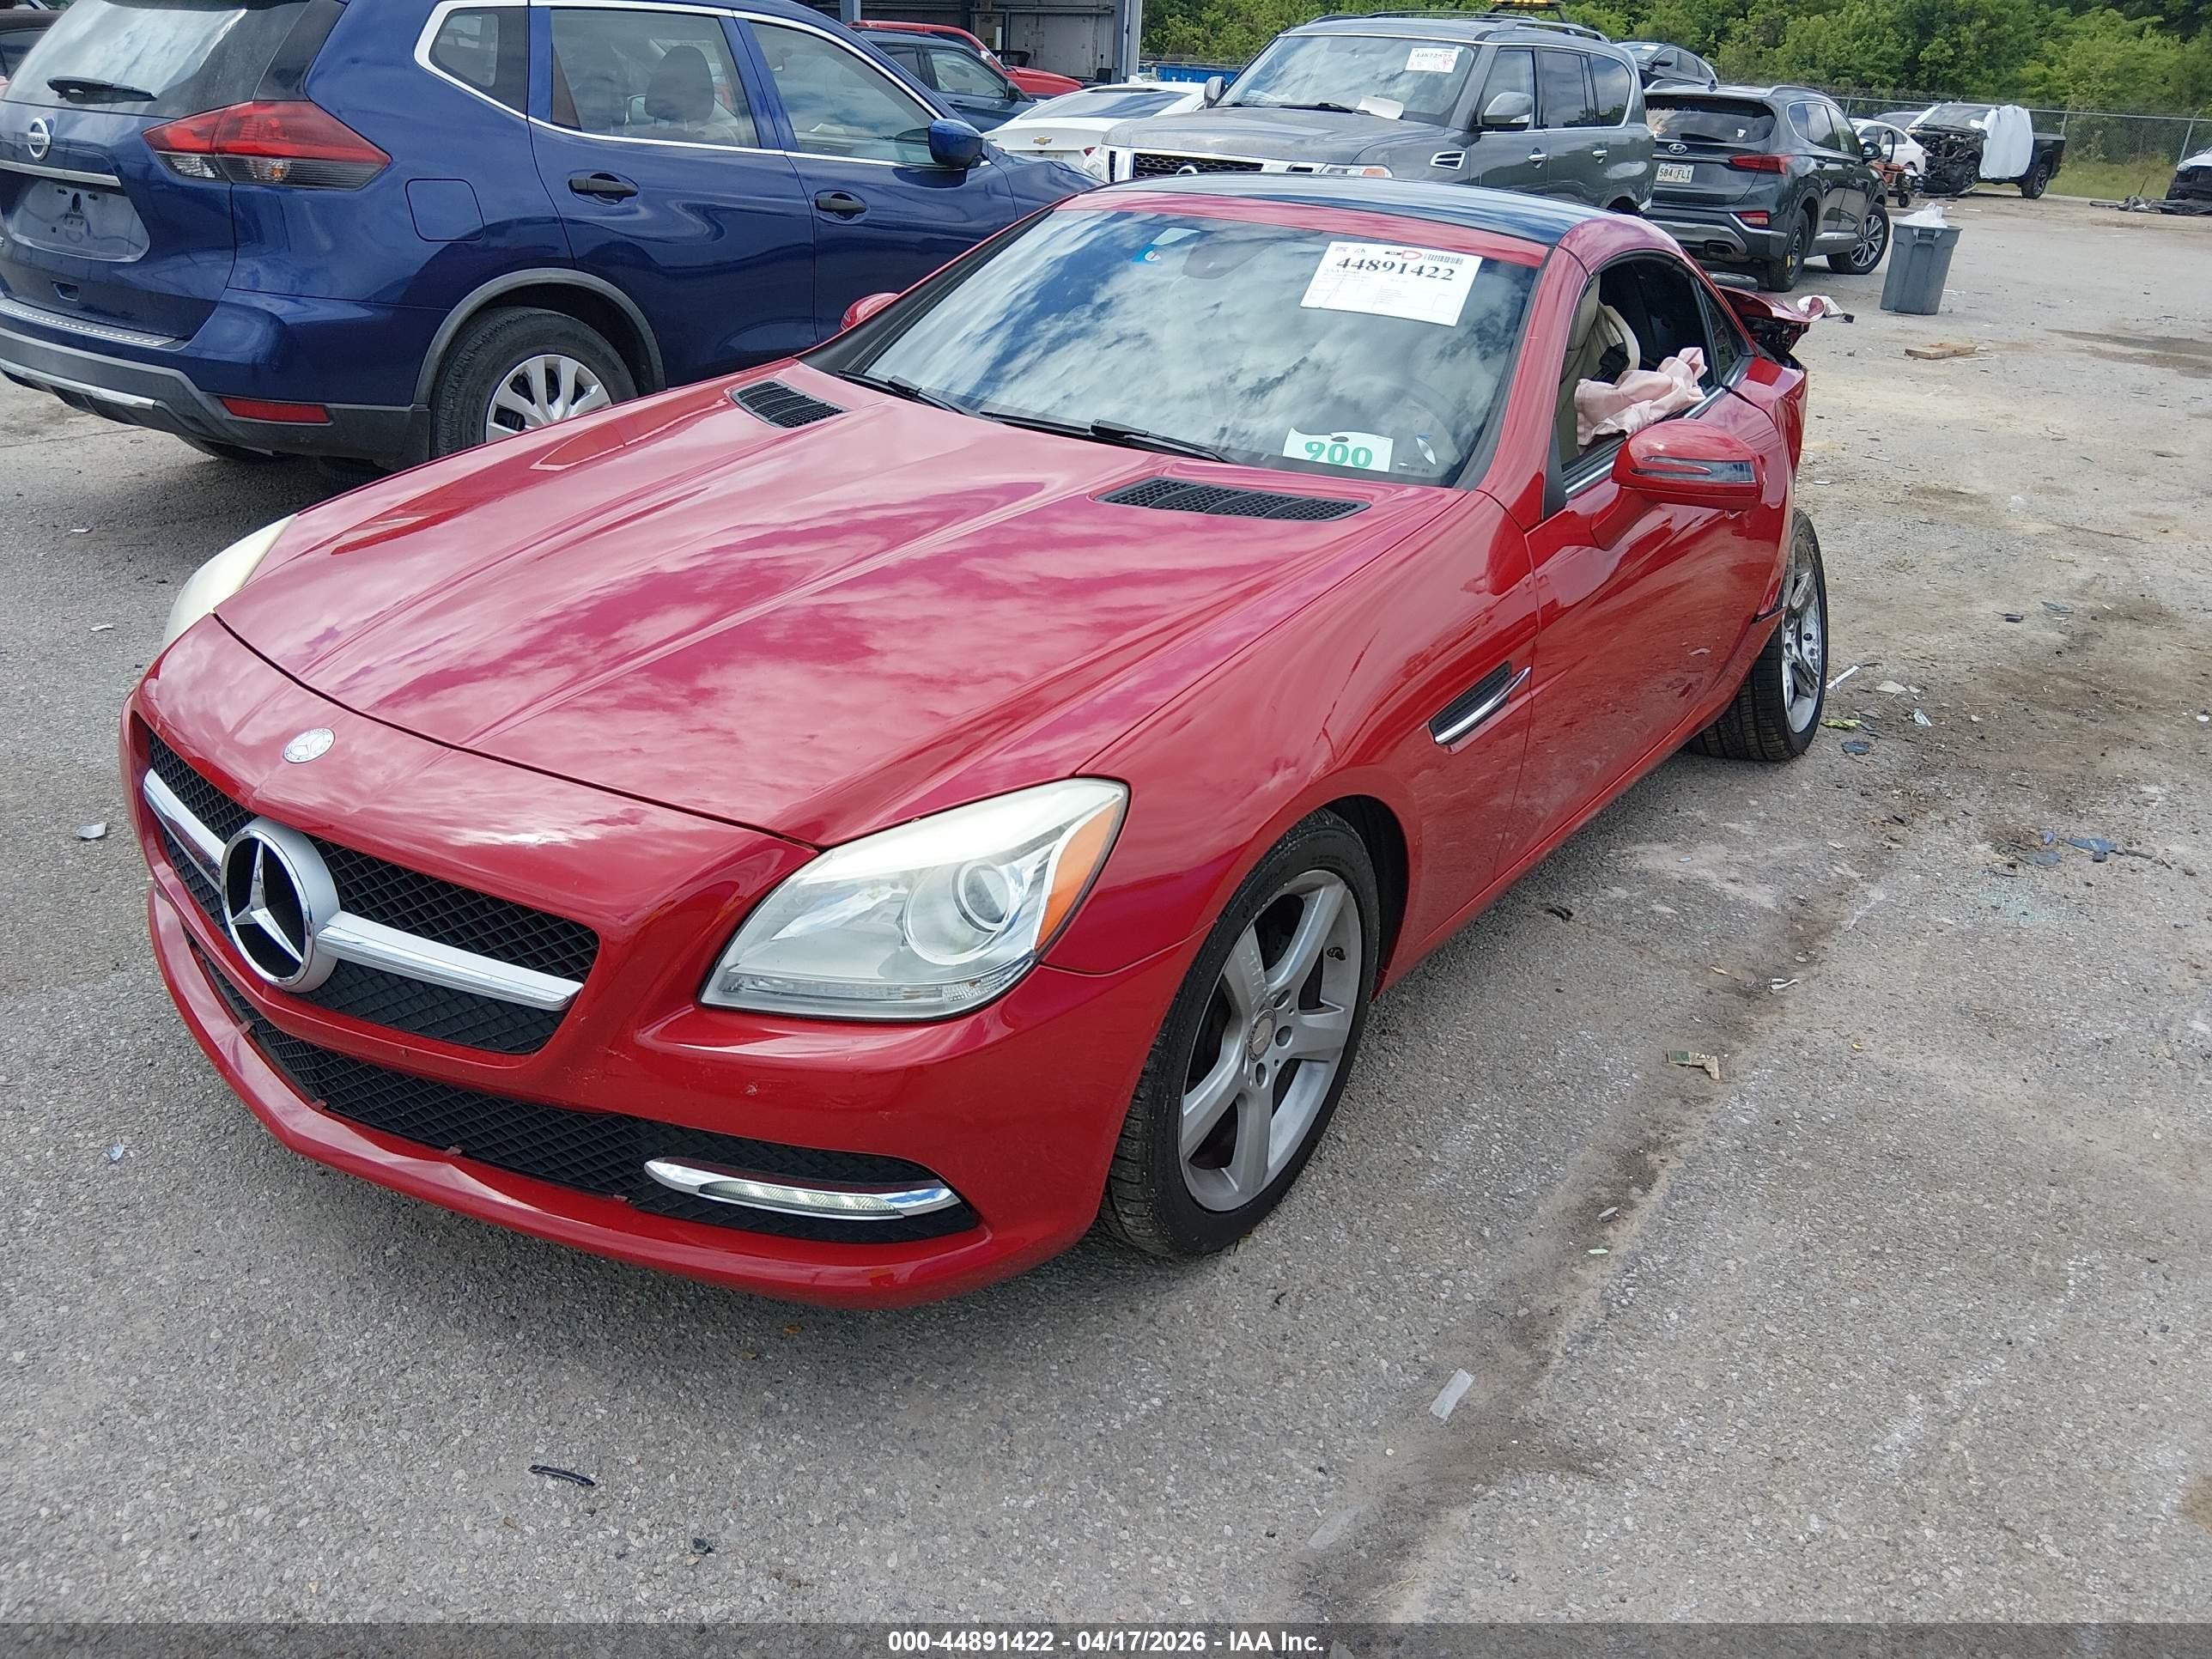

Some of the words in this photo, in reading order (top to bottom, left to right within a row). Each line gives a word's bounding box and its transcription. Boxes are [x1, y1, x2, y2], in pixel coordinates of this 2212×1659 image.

[1659, 167, 1673, 177] 584
[1336, 257, 1455, 282] 44891422
[1304, 441, 1373, 468] 900
